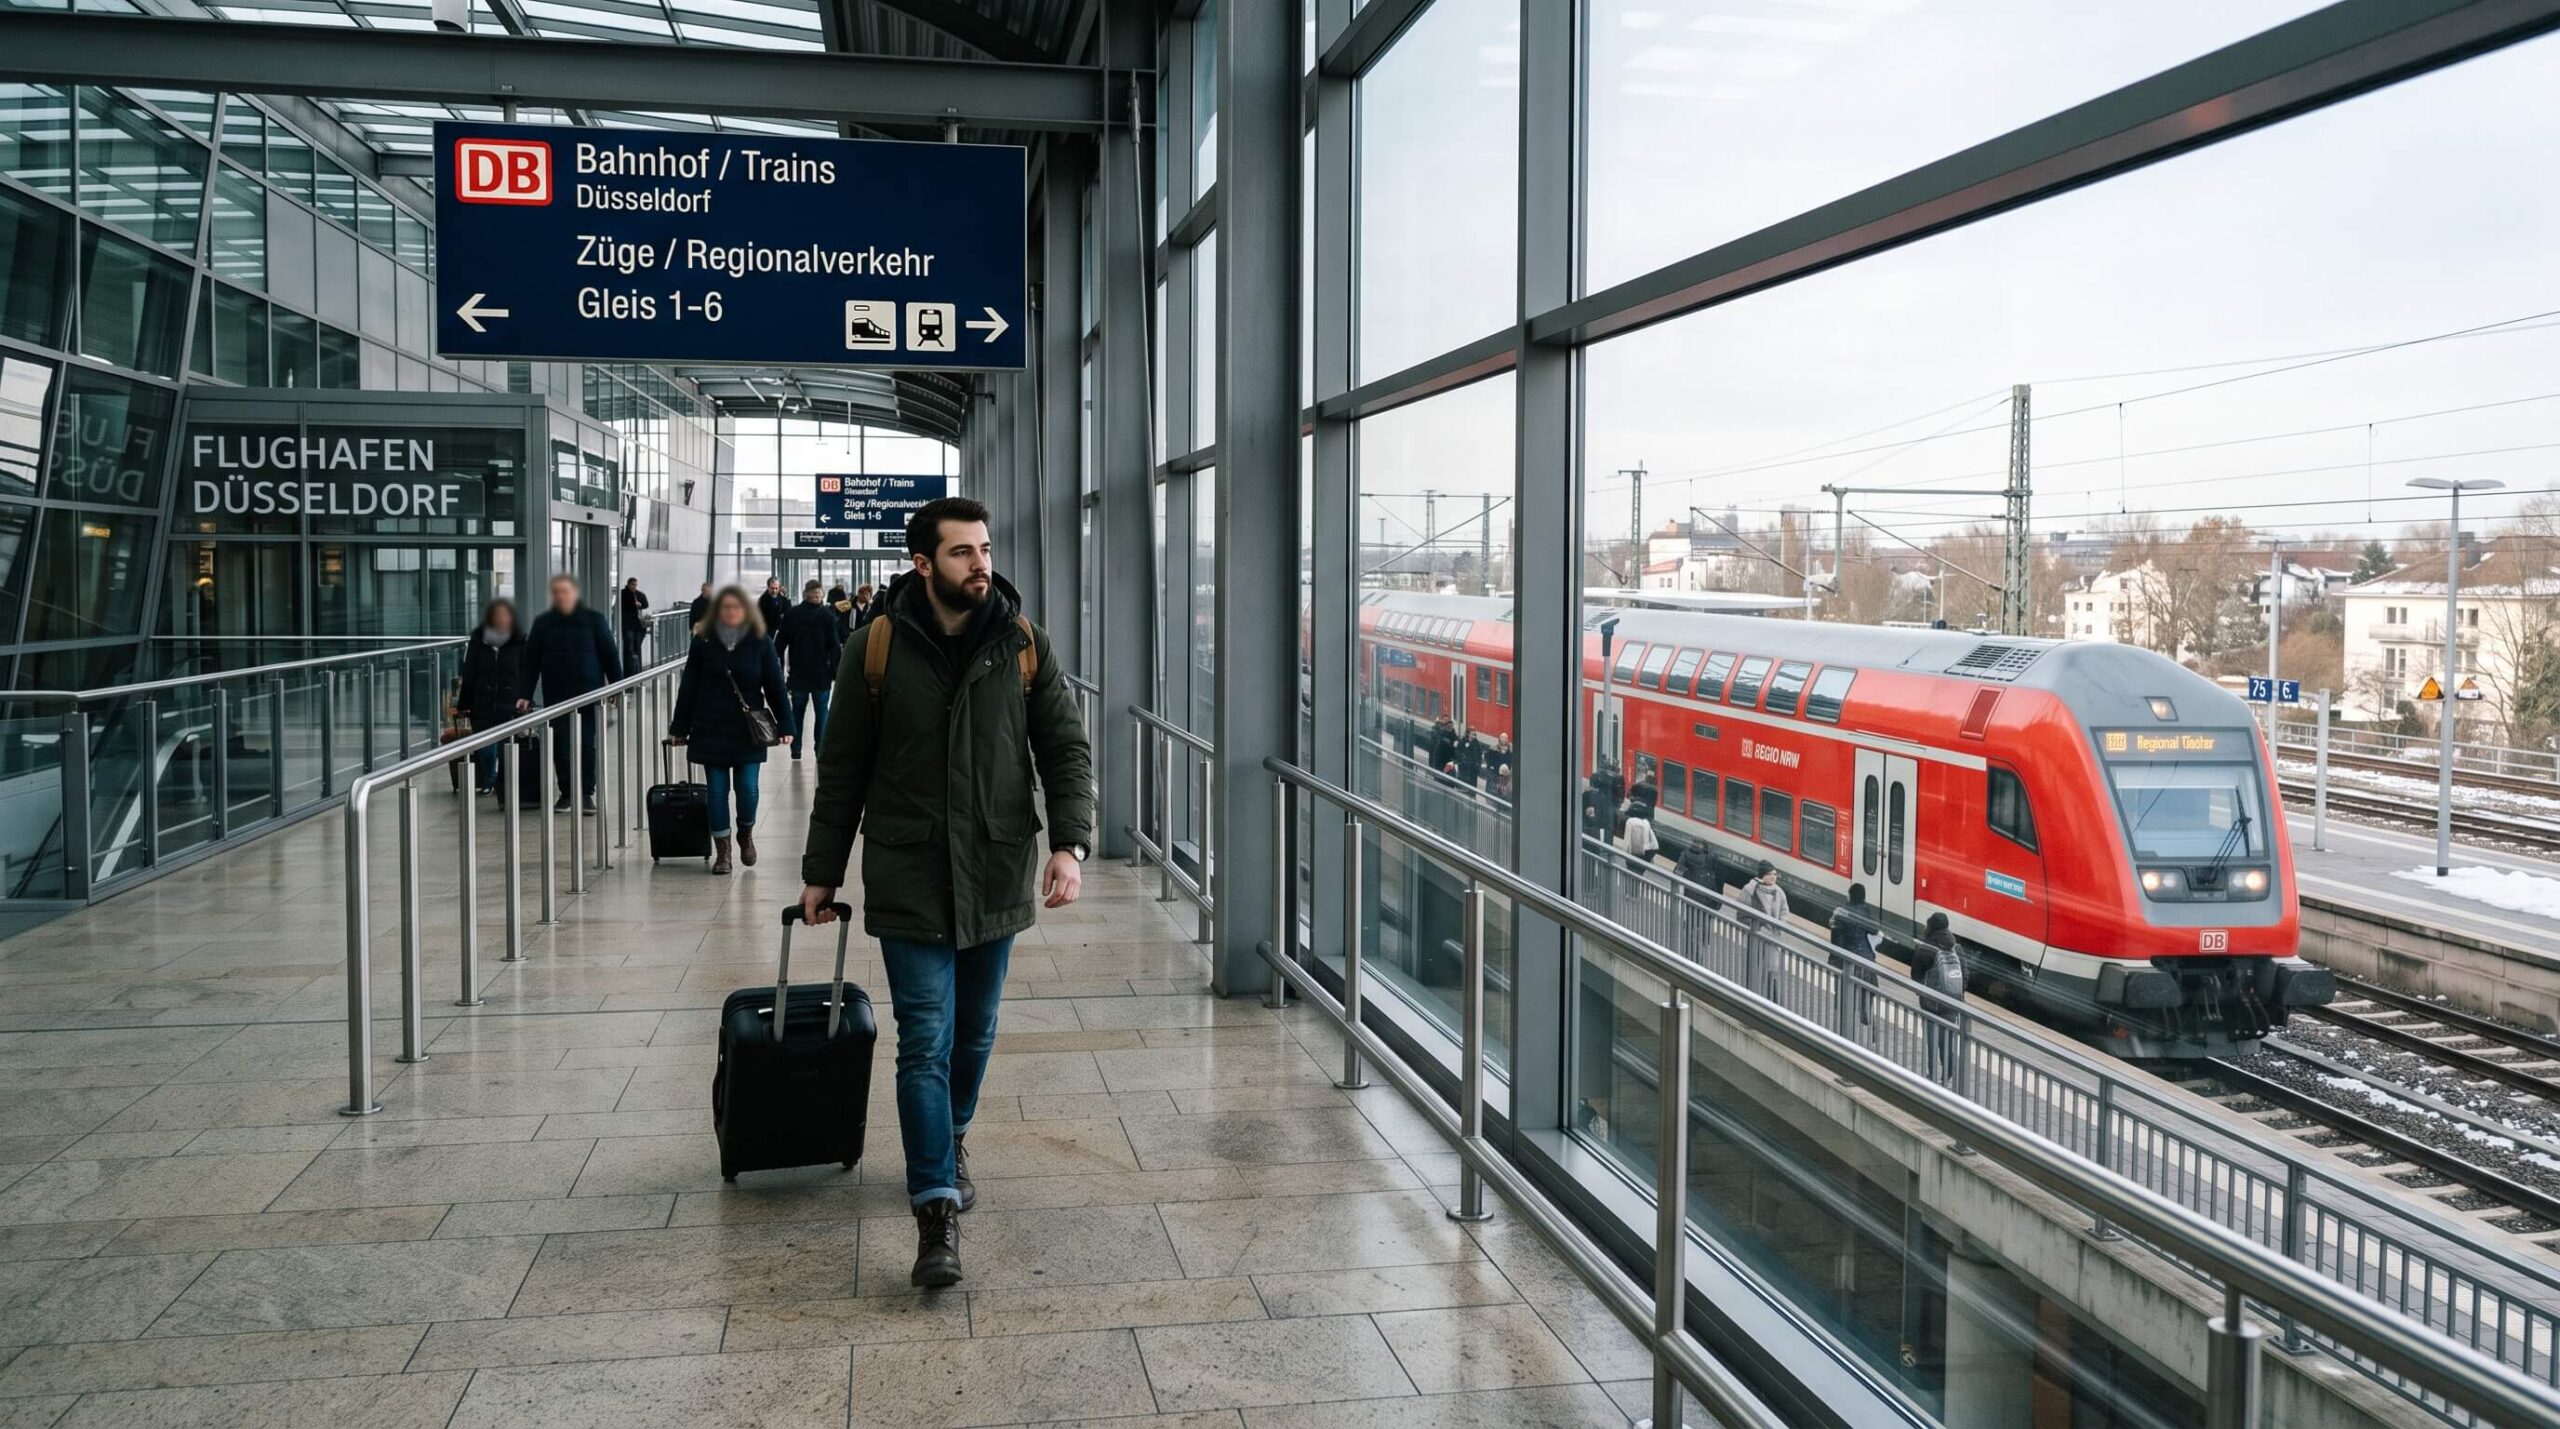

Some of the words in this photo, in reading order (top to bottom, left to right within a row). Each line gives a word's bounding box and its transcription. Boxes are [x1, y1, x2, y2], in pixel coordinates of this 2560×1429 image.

[468, 150, 541, 194] DB
[576, 143, 710, 179] Bahnhof
[718, 149, 731, 181] /
[742, 149, 837, 184] Trains
[576, 183, 711, 213] Düsseldorf
[576, 234, 655, 275] Züge
[664, 237, 677, 270] /
[686, 239, 935, 279] Regionalverkehr
[578, 287, 656, 320] Gleis
[194, 435, 434, 471] FLUGHAFEN
[194, 475, 461, 516] DÜSSELDORF
[888, 478, 915, 488] Trains
[2202, 933, 2225, 949] DB
